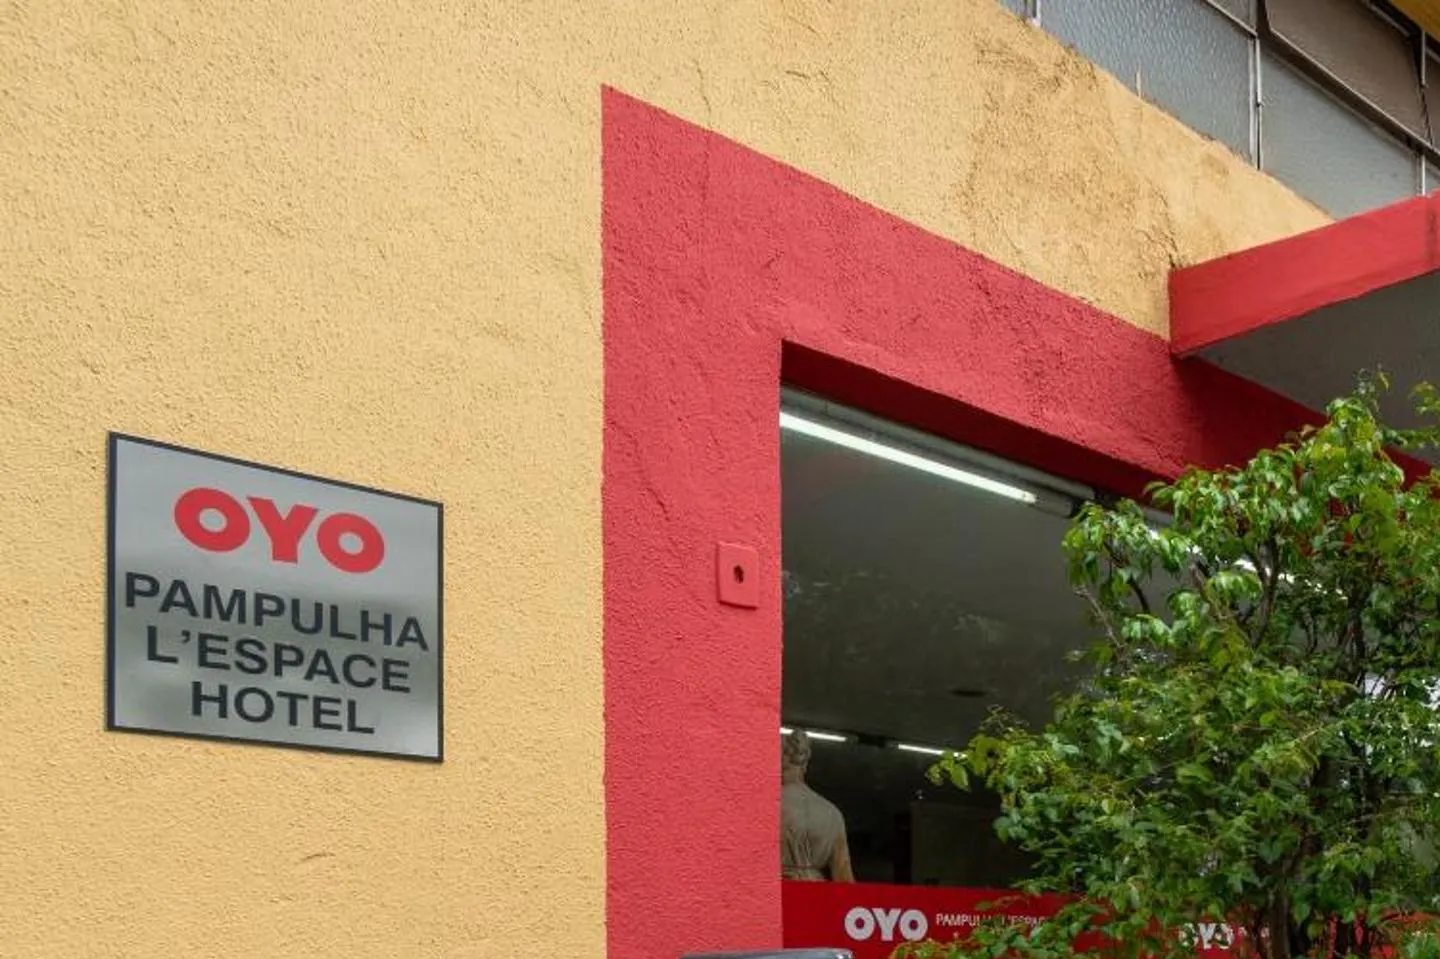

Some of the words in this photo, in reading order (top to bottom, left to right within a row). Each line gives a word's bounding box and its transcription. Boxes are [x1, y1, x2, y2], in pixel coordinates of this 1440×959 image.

[174, 487, 385, 573] OYO
[125, 572, 428, 650] PAMPULHA
[147, 625, 411, 693] L'ESPACE
[192, 681, 374, 734] HOTEL
[844, 906, 928, 941] OYO
[936, 913, 993, 926] PAMPUL
